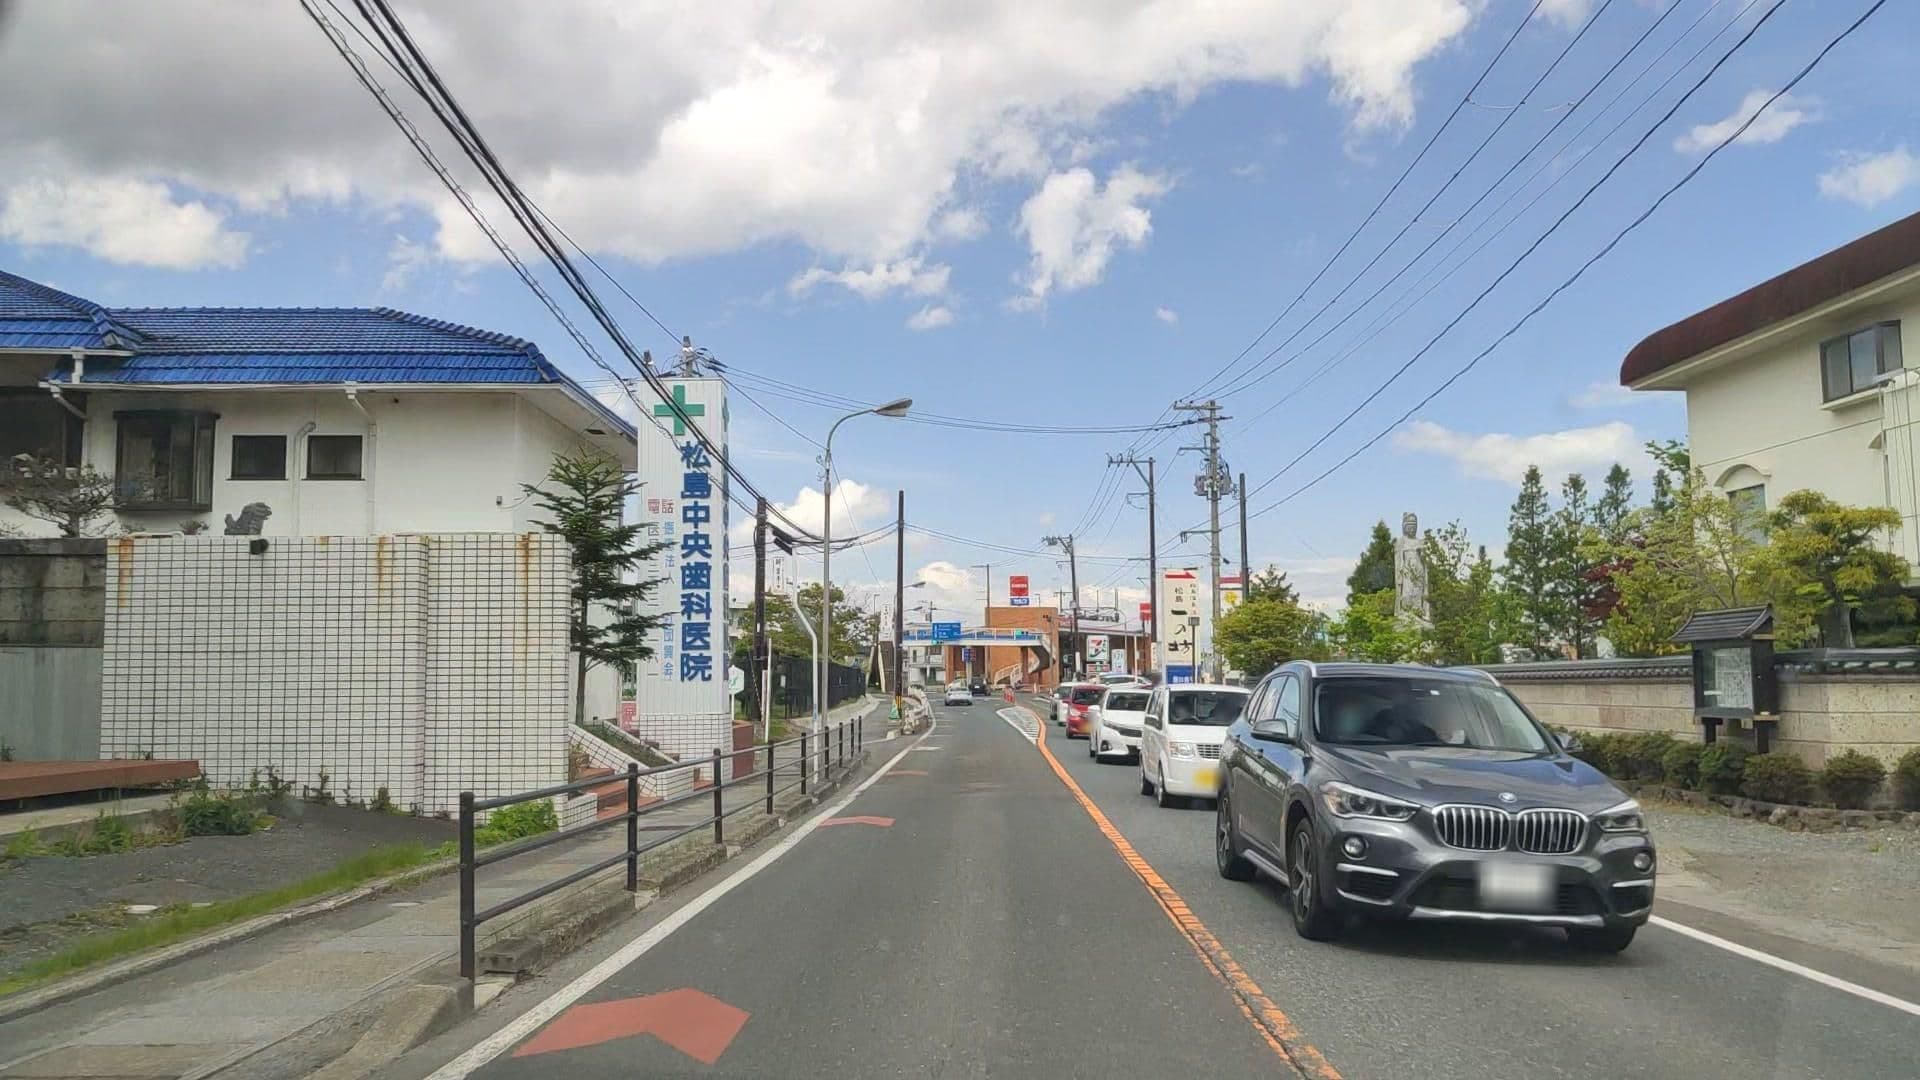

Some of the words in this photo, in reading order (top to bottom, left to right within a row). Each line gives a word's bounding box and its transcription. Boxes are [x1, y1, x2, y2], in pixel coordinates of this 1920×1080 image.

[648, 498, 674, 514] 電話
[680, 440, 712, 682] 松島中央歯科医院
